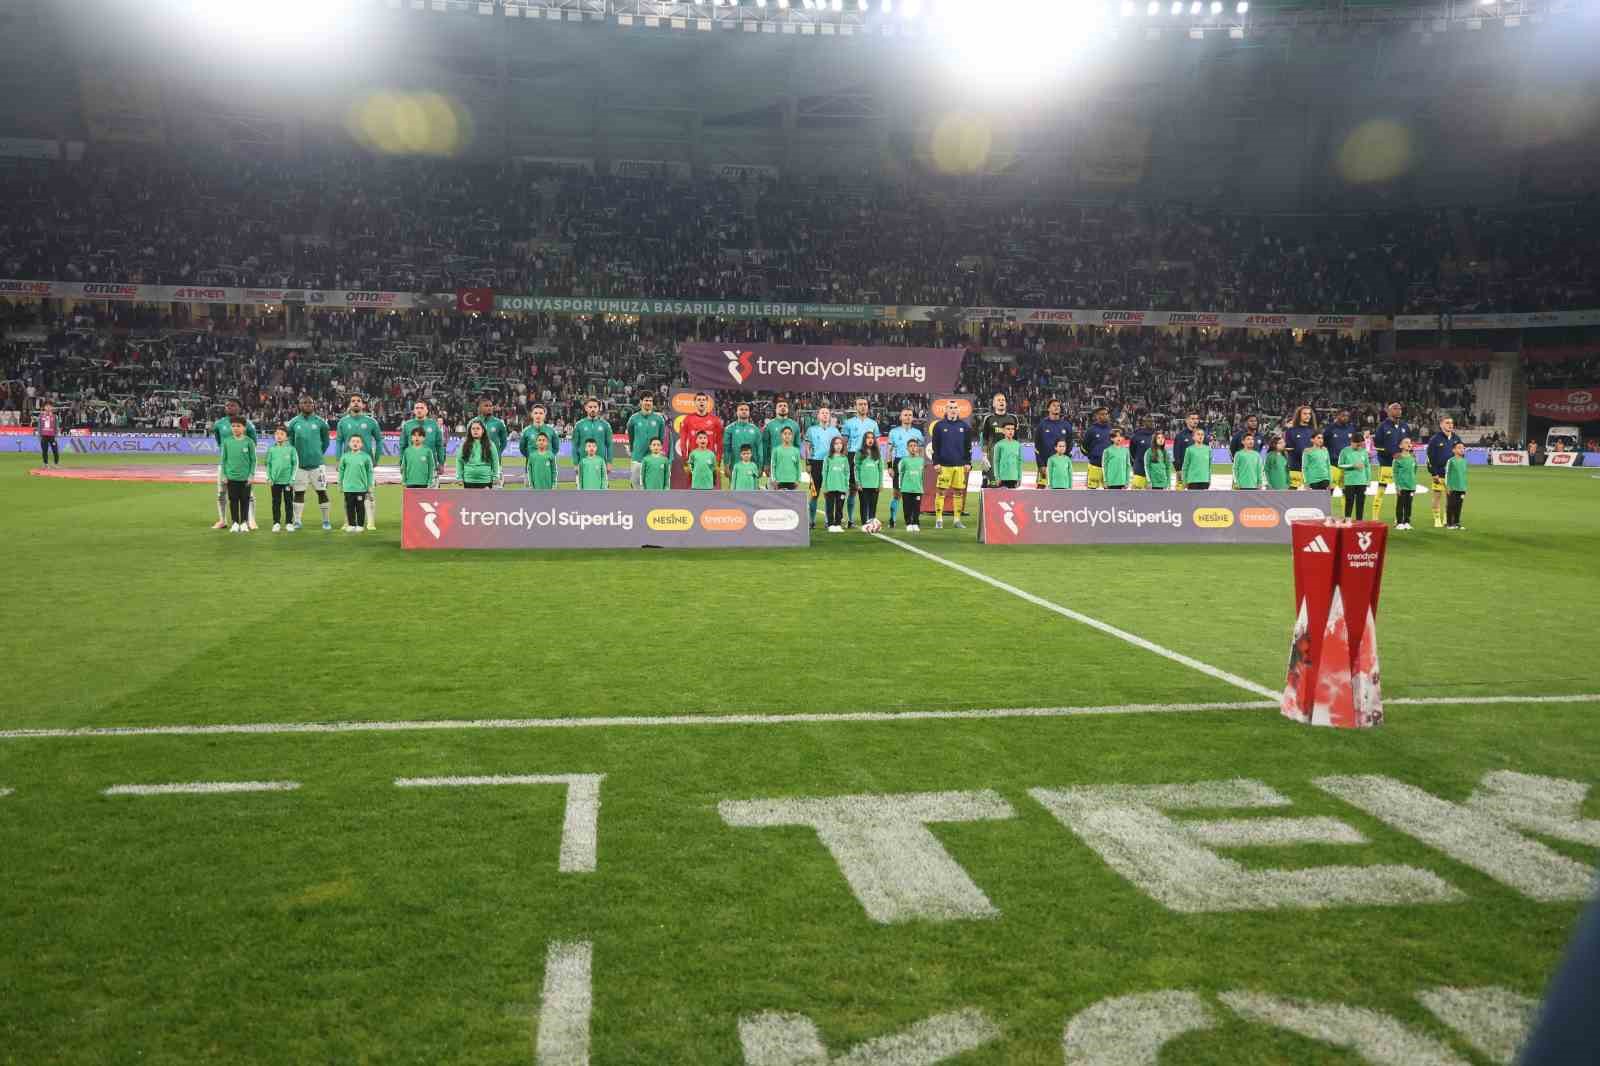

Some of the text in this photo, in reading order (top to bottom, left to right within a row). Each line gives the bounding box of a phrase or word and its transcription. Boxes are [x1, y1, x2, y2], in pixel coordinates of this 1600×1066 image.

[502, 298, 650, 313] KONYASPOR'UMUZA
[654, 301, 736, 315] BAŞARILAR
[740, 301, 798, 316] DİLERİM
[757, 356, 850, 380] trendyol
[89, 439, 182, 452] MASLAK
[460, 507, 555, 530] trendyol
[1033, 505, 1117, 526] trendyol
